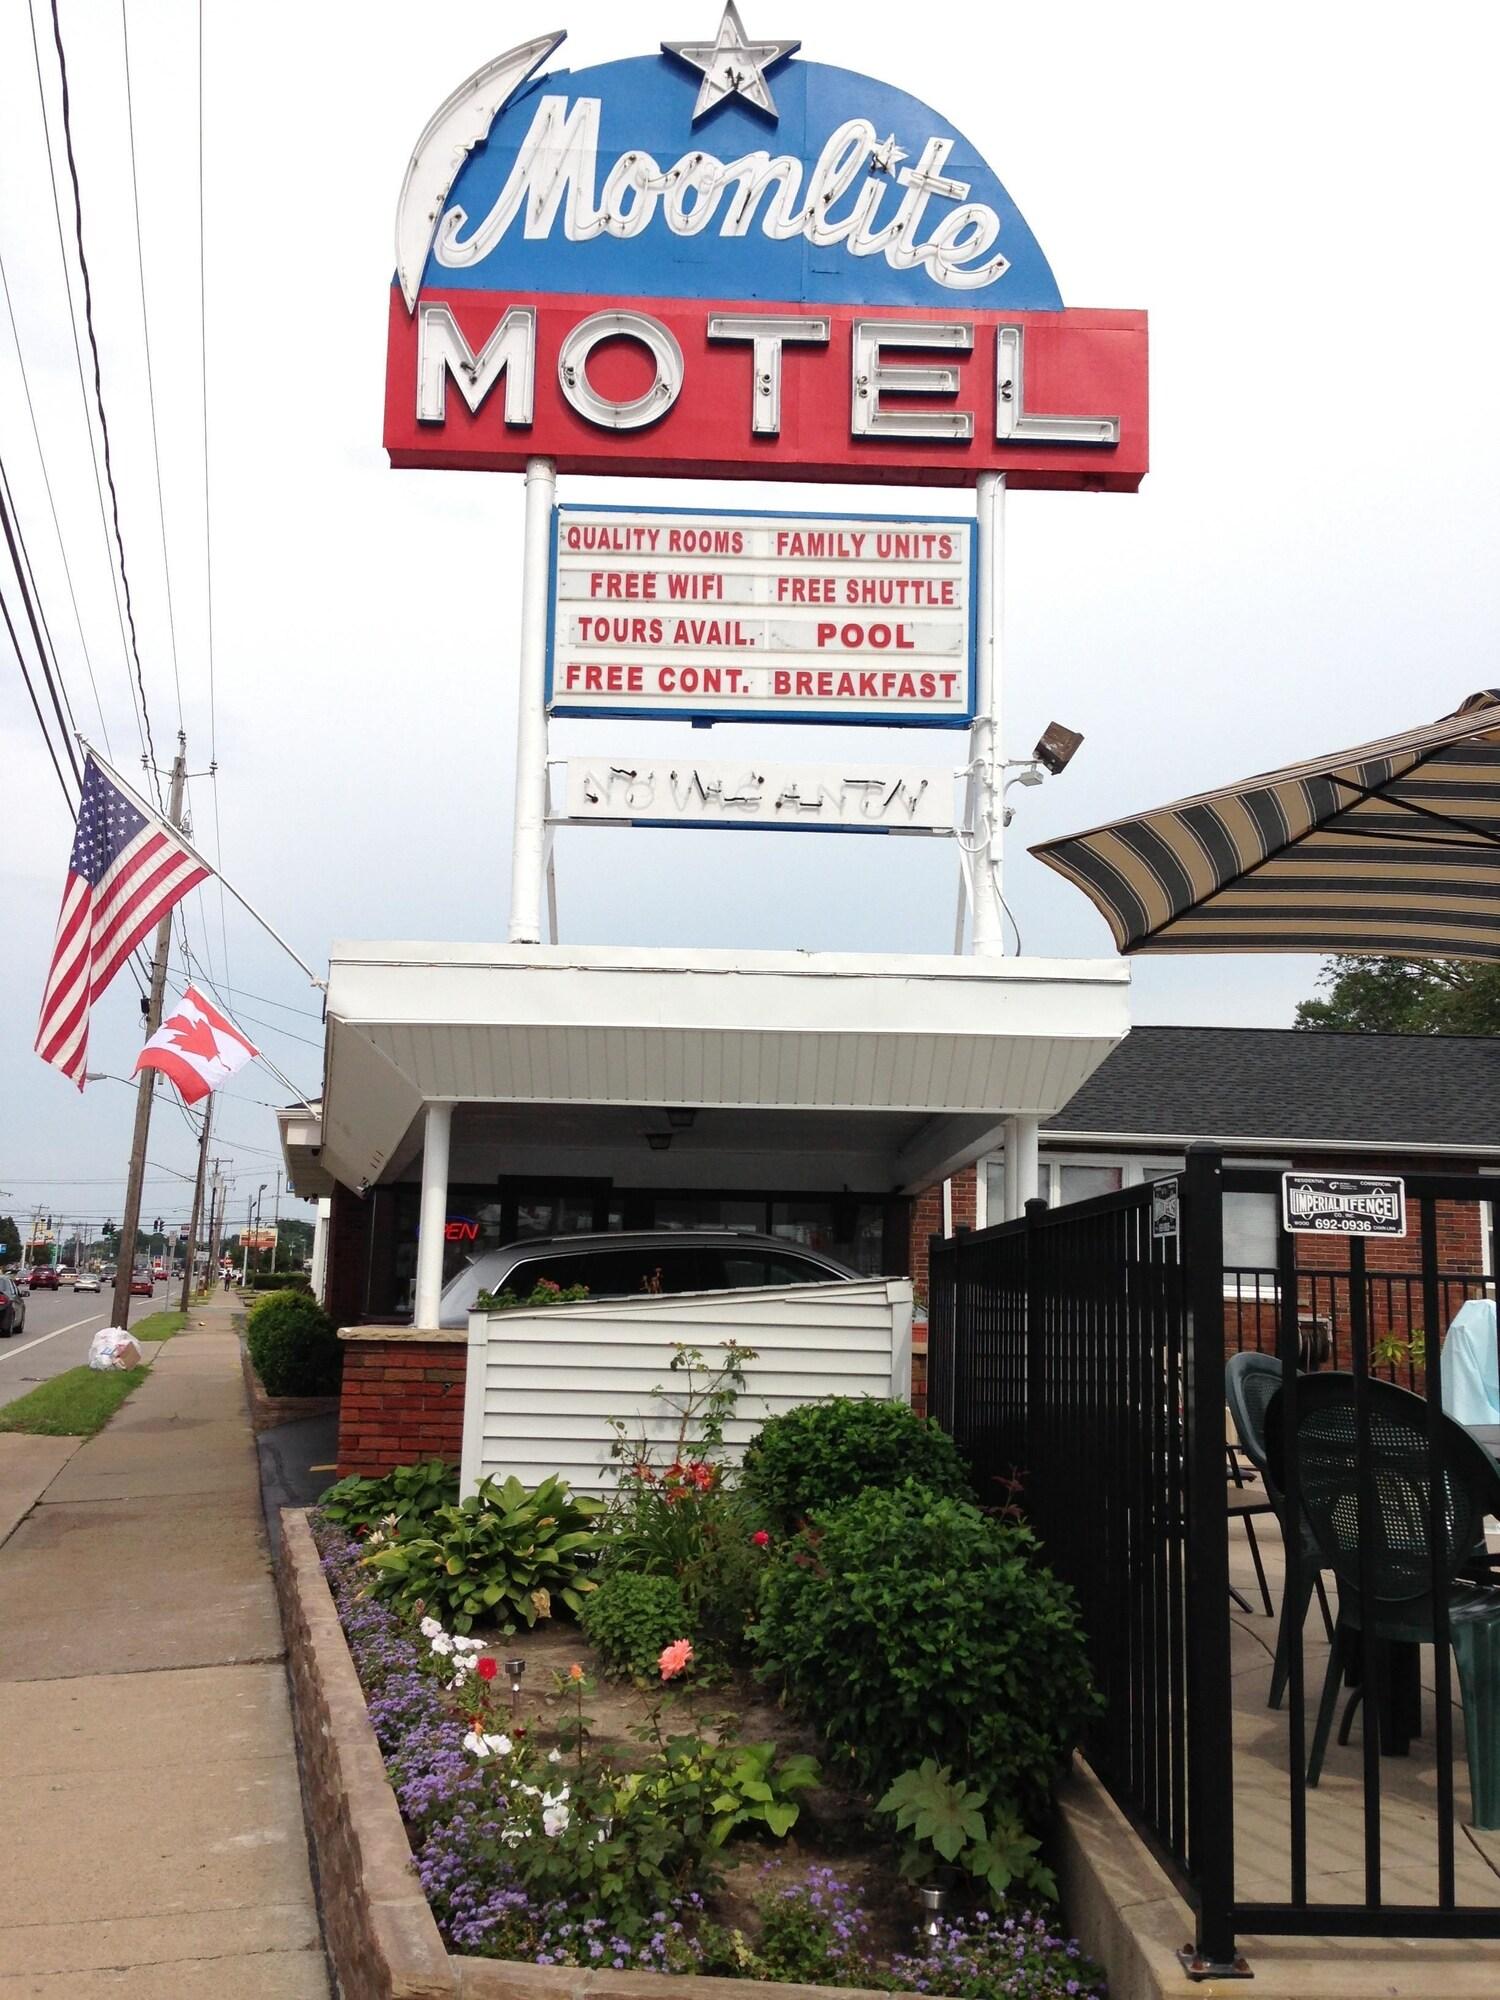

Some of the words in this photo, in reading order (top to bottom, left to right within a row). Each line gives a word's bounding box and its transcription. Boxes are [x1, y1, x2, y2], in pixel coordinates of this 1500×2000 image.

[432, 95, 1012, 290] Moonlite
[416, 301, 1120, 446] MOTEL
[567, 526, 659, 551] QUALITY
[668, 529, 744, 554] ROOMS
[776, 531, 865, 558] FAMILY
[876, 533, 952, 559] UNITS
[590, 572, 657, 599] FREE
[668, 574, 723, 599] WIFI
[777, 577, 836, 603] FREE
[846, 579, 954, 605] SHUTTLE
[578, 616, 663, 643] TOURS
[673, 619, 755, 646] AVAIL.
[816, 622, 915, 649] POOL
[566, 664, 643, 692] FREE
[657, 666, 750, 693] CONT.
[773, 671, 956, 699] BREAKFAST
[1296, 1193, 1340, 1213] IMPERIAL
[1350, 1198, 1392, 1216] FENCE
[1315, 1219, 1371, 1231] 692-0936
